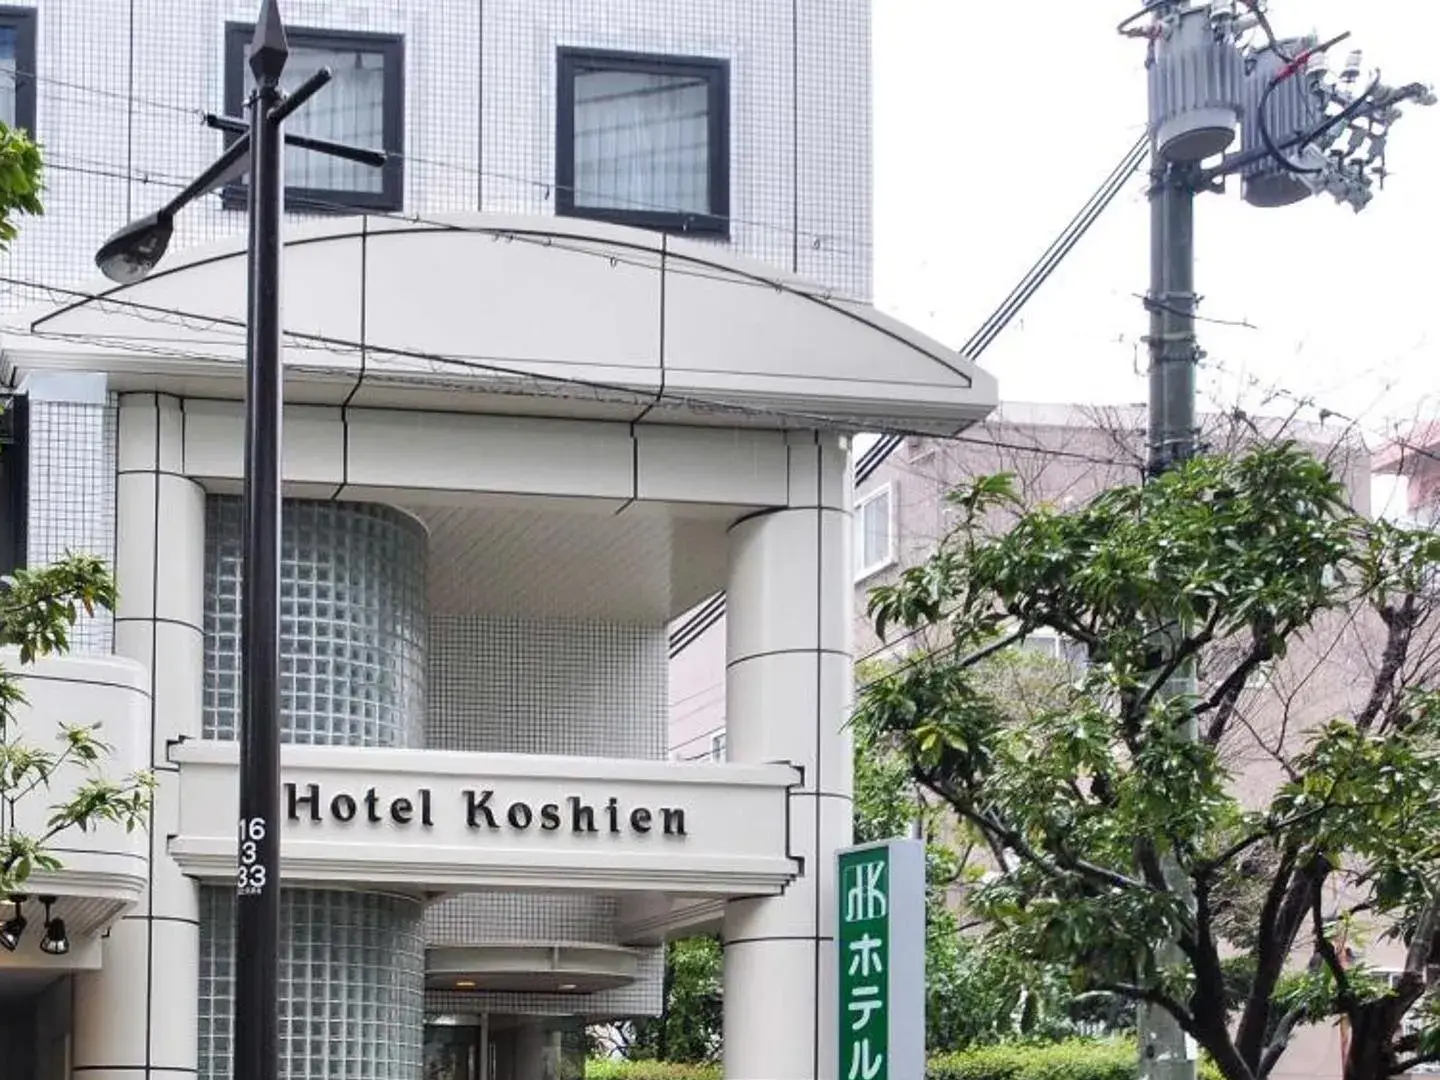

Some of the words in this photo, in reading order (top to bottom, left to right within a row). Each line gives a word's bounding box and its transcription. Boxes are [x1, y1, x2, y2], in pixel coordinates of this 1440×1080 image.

[284, 782, 434, 826] Hotel
[462, 789, 688, 835] Koshien
[240, 817, 266, 841] 16
[242, 841, 257, 864] 3
[238, 865, 266, 887] 33
